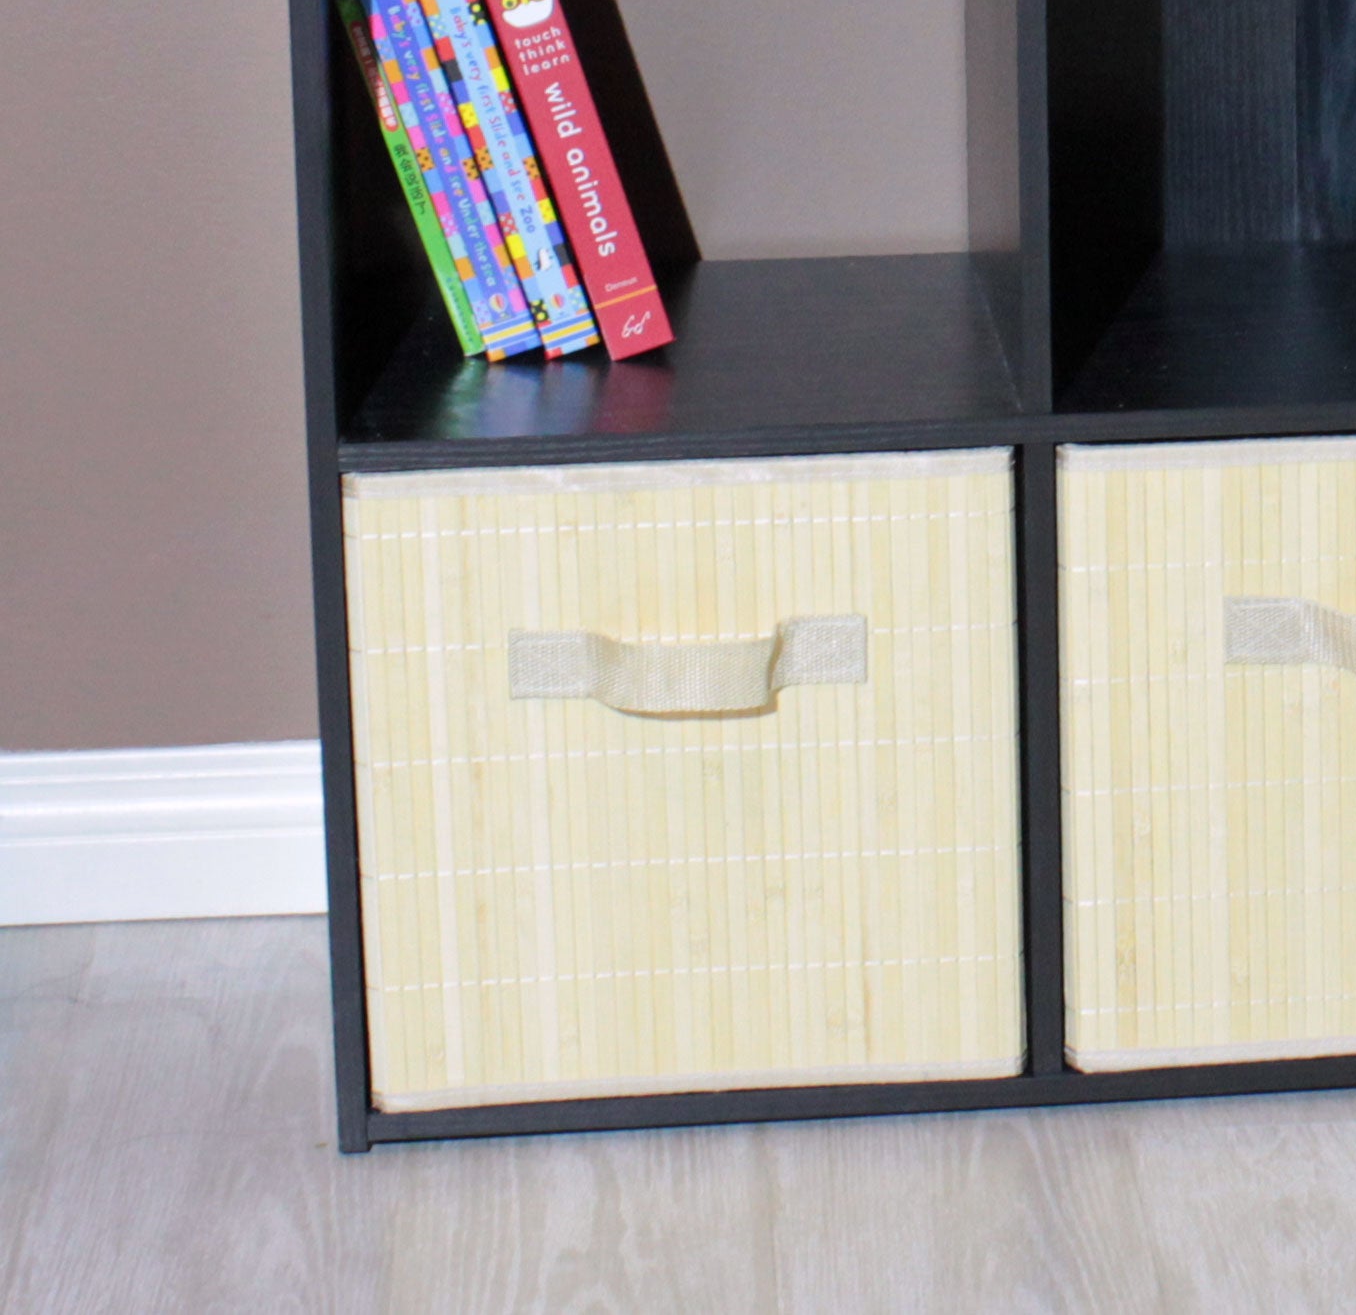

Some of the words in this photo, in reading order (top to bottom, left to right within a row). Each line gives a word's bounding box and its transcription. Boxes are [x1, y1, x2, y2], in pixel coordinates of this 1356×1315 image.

[387, 5, 412, 48] baby's
[449, 6, 472, 47] baby's
[514, 26, 562, 50] touch
[404, 50, 421, 80] very
[519, 39, 566, 63] think
[522, 53, 570, 76] learn
[466, 51, 482, 81] very
[415, 83, 435, 113] first
[477, 85, 496, 114] first
[488, 114, 506, 147] Slide
[438, 148, 458, 173] and
[502, 151, 520, 177] and
[544, 81, 582, 139] wild
[566, 148, 618, 257] animals
[450, 175, 465, 197] see
[510, 178, 525, 201] see
[458, 198, 480, 238] Under
[520, 205, 536, 234] Zoo
[474, 240, 488, 262] the
[480, 262, 497, 286] Sea
